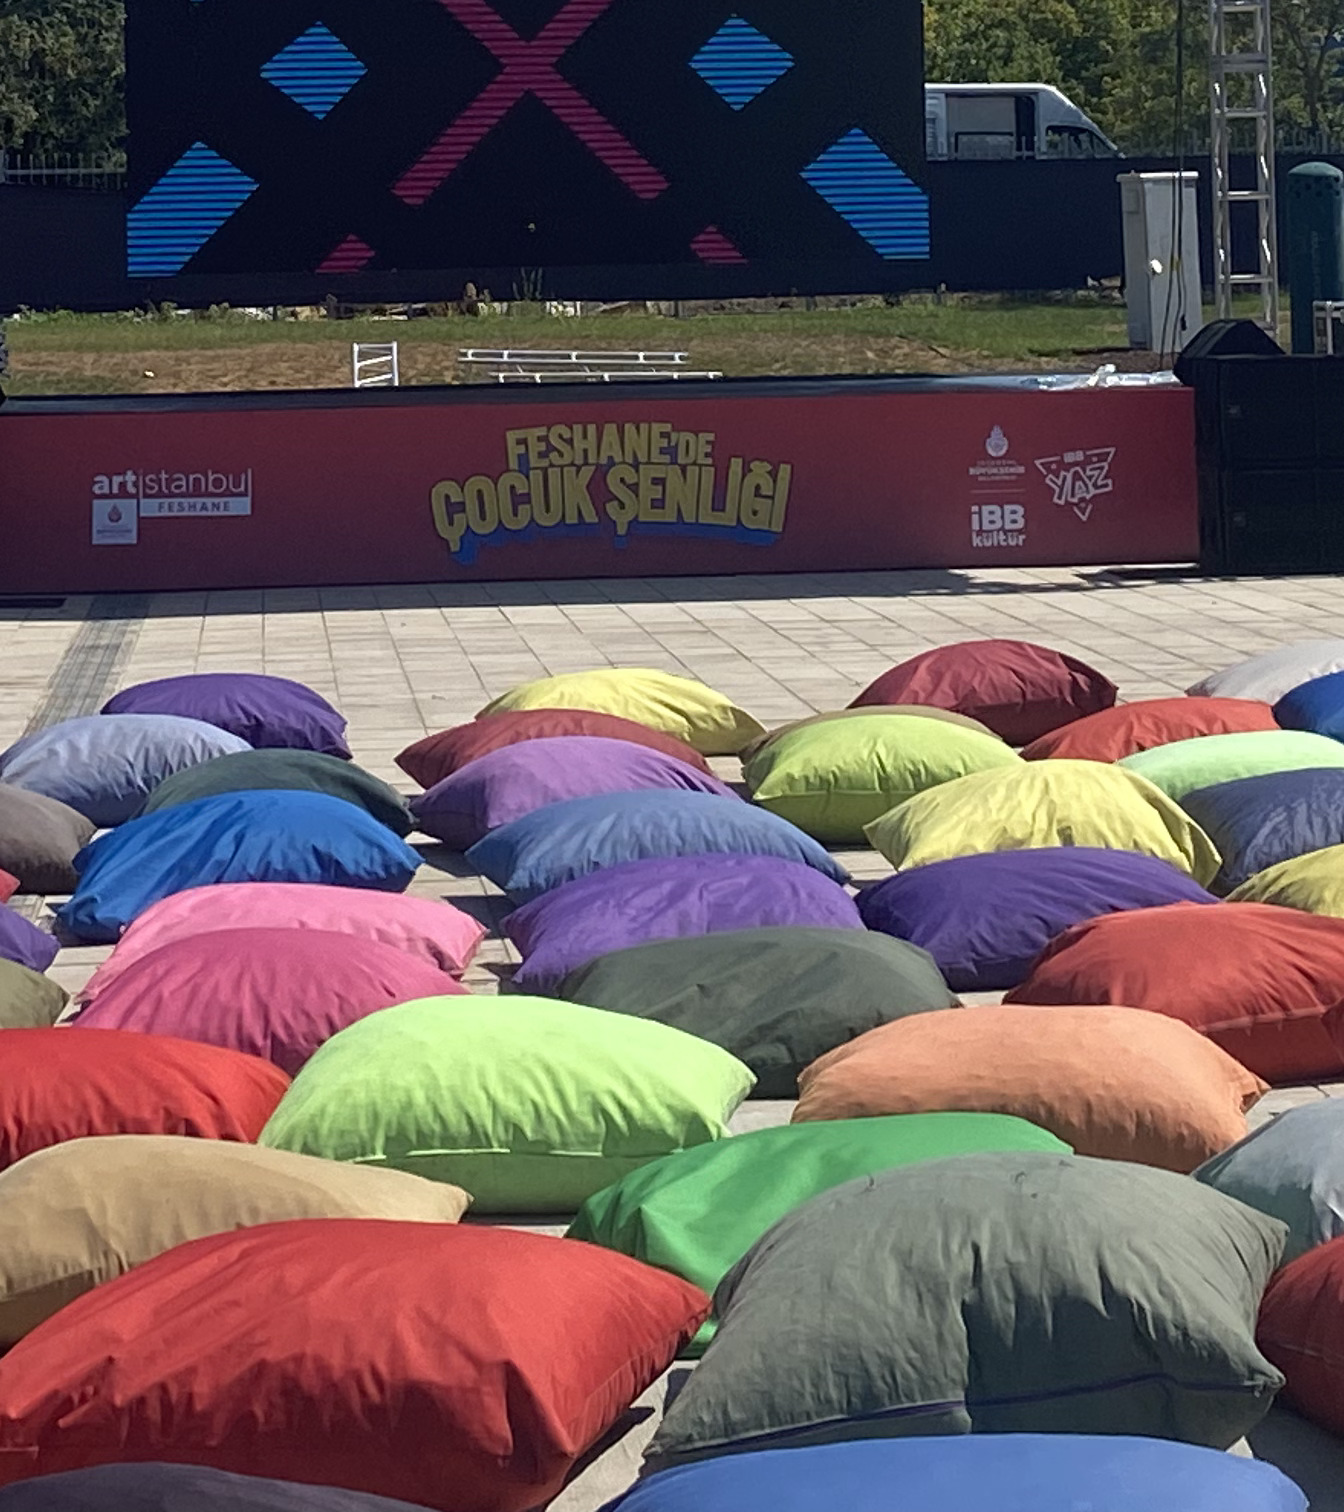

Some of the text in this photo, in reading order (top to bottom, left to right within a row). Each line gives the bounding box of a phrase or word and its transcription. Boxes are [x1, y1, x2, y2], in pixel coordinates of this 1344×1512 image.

[506, 422, 716, 470] FESHANE'DE
[1045, 462, 1113, 506] YAZ
[158, 501, 231, 513] FESHANE
[431, 465, 599, 553] ÇOCUK
[972, 530, 1026, 548] kültür
